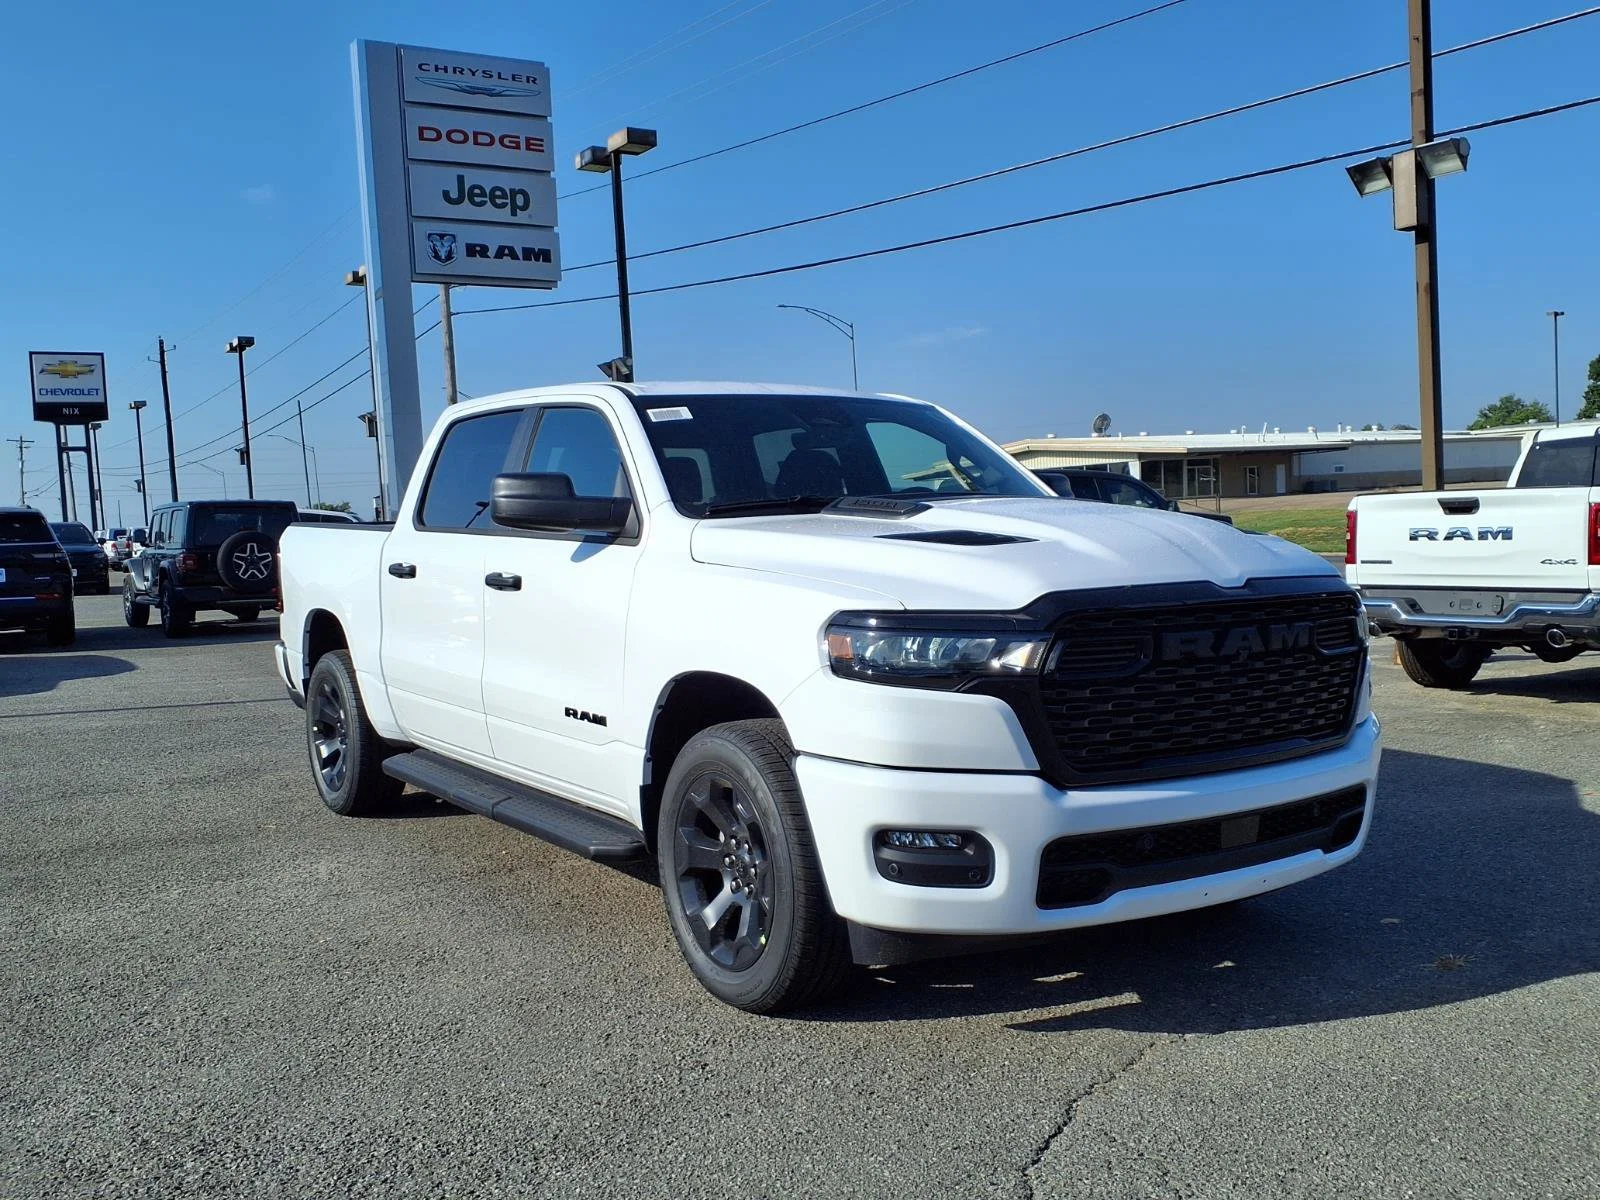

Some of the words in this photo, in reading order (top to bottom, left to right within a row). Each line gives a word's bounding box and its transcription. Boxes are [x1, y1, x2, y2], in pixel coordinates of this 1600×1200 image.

[417, 62, 538, 85] CHRYSLER
[417, 125, 545, 153] DODGE
[442, 174, 531, 217] Jeep
[465, 242, 552, 263] RAM
[39, 387, 100, 396] CHEVROLET
[62, 407, 80, 415] NIX
[1409, 526, 1513, 541] RAM
[1161, 622, 1314, 661] RAM
[564, 706, 608, 727] RAM
